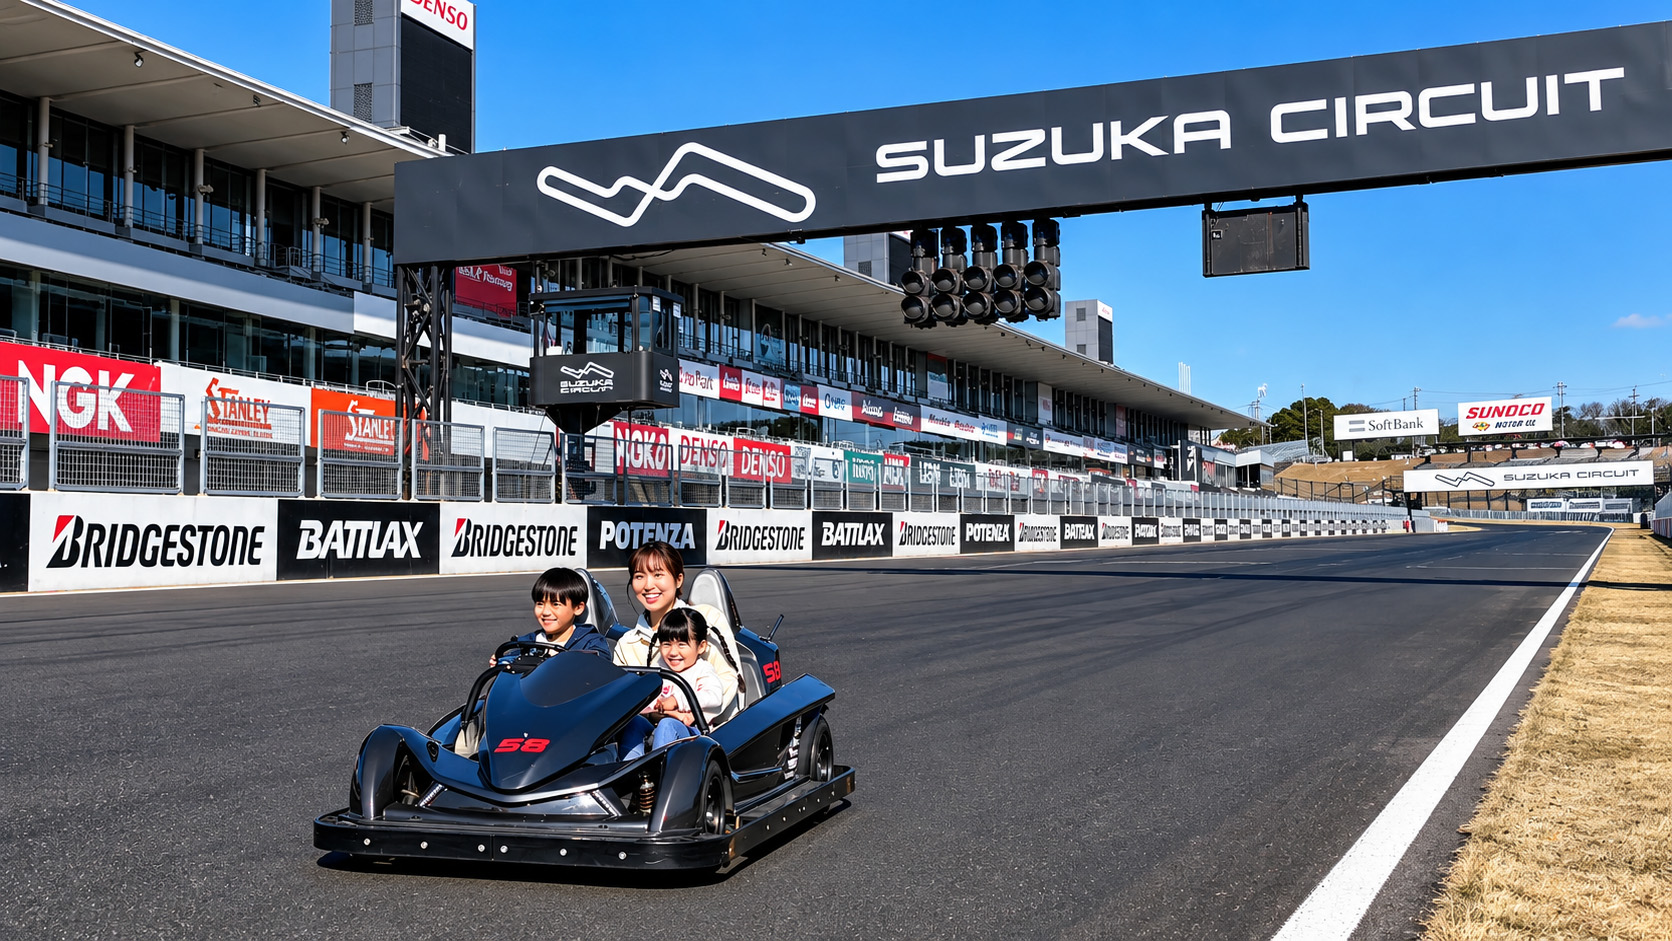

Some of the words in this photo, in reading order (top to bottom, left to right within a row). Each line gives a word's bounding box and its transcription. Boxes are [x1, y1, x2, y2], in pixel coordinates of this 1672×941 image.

[411, 0, 468, 31] ENSO
[875, 109, 1232, 184] SUZUKA
[1270, 67, 1626, 145] CIRCUIT
[18, 360, 135, 433] NGK
[205, 377, 271, 424] STANLEY
[1465, 403, 1545, 419] SUNOCO
[1368, 417, 1424, 431] SoftBank
[680, 435, 728, 468] DENSO
[741, 446, 786, 478] DENSO
[1503, 471, 1571, 482] SUZUKA
[1576, 469, 1640, 479] CIRCUIT
[46, 515, 266, 569] BRIDGESTONE
[296, 519, 424, 560] BATTLAX
[451, 518, 578, 558] BRIDGESTONE
[599, 520, 696, 550] POTENZA
[715, 520, 806, 551] BRIDGESTONE
[821, 522, 886, 547] BATTLAX
[899, 521, 956, 546] BRIDGESTONE
[763, 660, 782, 684] 58
[494, 738, 551, 753] 58
